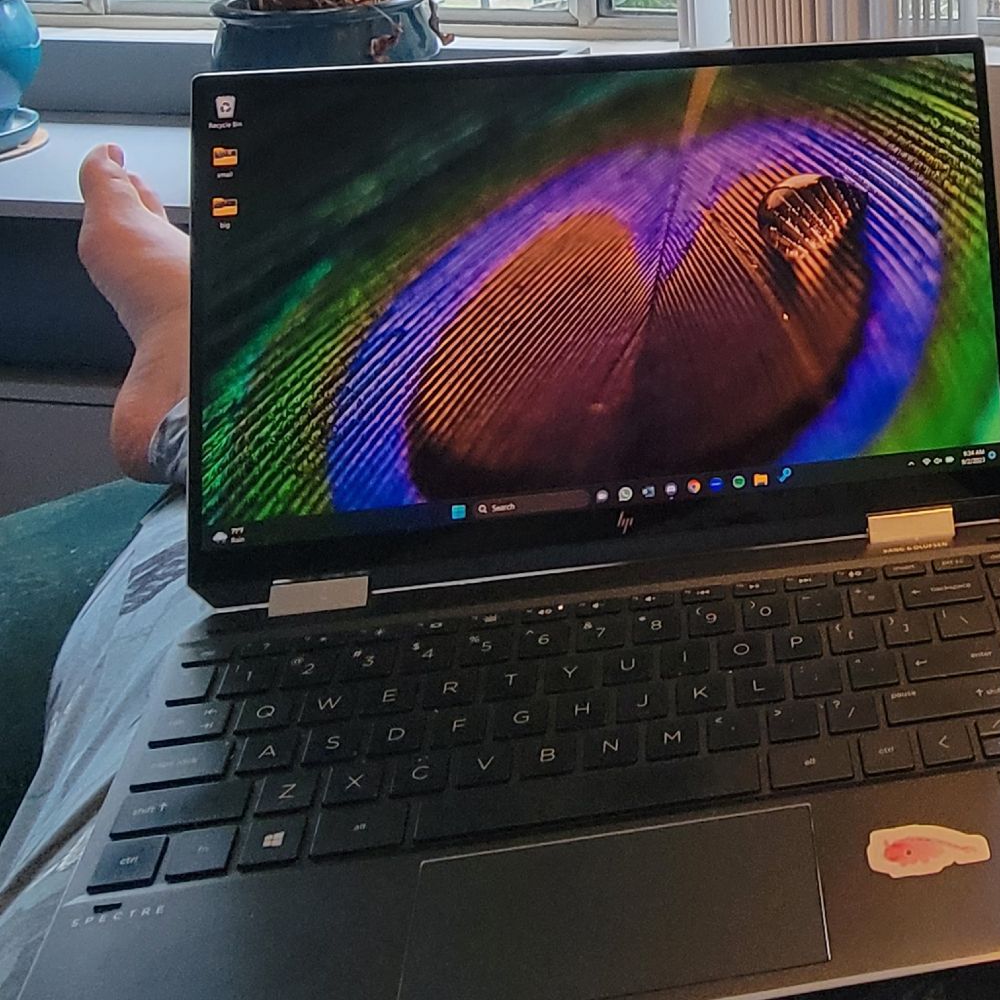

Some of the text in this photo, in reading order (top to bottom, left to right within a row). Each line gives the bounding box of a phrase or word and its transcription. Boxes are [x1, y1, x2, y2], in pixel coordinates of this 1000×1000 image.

[232, 120, 243, 128] Bin
[491, 502, 516, 513] Search
[883, 545, 905, 554] BANG
[914, 541, 949, 551] OLUFSEN
[930, 582, 972, 593] backspace
[650, 618, 663, 631] 8
[705, 612, 718, 624] 9
[537, 633, 550, 646] 6
[595, 626, 606, 639] 7
[481, 641, 493, 652] 5
[732, 642, 751, 657] O
[789, 635, 804, 649] P
[362, 655, 376, 668] 3
[421, 648, 434, 660] 4
[970, 650, 993, 660] enter
[301, 662, 316, 676] 2
[561, 664, 579, 680] Y
[619, 657, 637, 672] U
[504, 673, 520, 687] T
[752, 678, 766, 692] L
[382, 688, 399, 703] E
[442, 681, 459, 695] R
[692, 685, 709, 701] K
[890, 688, 917, 700] pause
[317, 695, 343, 711] W
[636, 693, 649, 708] J
[256, 704, 276, 720] Q
[512, 709, 531, 725] G
[573, 701, 591, 718] H
[451, 717, 468, 733] F
[387, 727, 406, 742] D
[663, 729, 682, 745] M
[324, 735, 341, 750] S
[602, 738, 620, 754] N
[257, 744, 277, 760] A
[539, 747, 557, 763] B
[476, 755, 495, 771] V
[411, 764, 431, 781] C
[344, 773, 365, 791] X
[277, 782, 297, 800] Z
[119, 855, 140, 866] ctrl
[71, 904, 168, 929] SPECTRE
